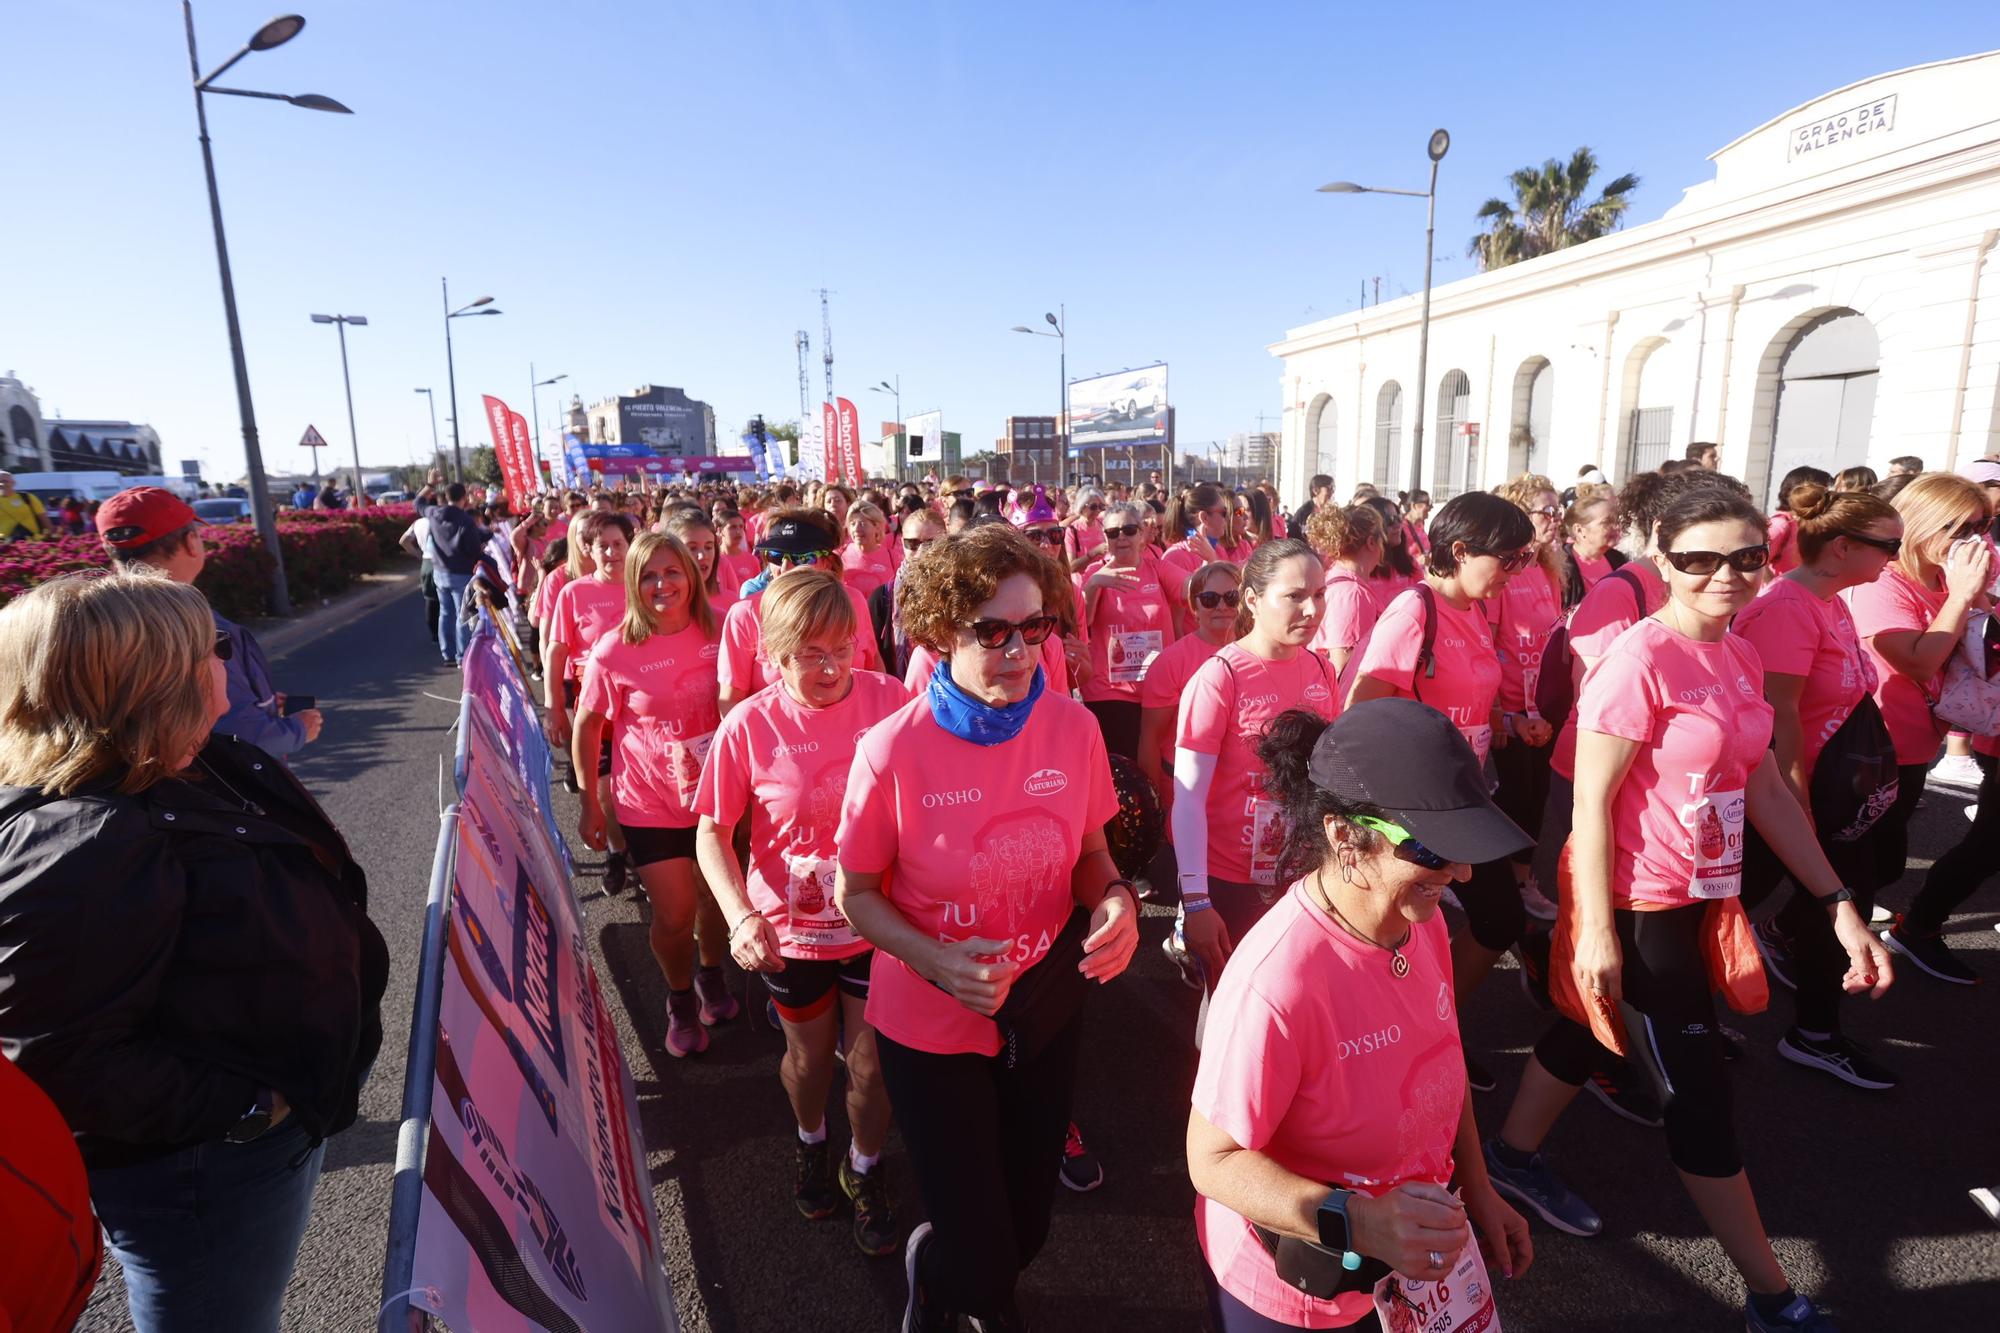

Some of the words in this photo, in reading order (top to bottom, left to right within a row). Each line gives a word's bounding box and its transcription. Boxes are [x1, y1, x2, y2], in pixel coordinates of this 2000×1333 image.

[1799, 117, 1848, 141] GRAO
[1858, 102, 1886, 122] DE
[1794, 117, 1887, 155] VALENCIA
[631, 403, 655, 412] PUERTO
[639, 658, 675, 673] OYSHO
[1239, 693, 1278, 709] OYSHO
[1680, 683, 1724, 702] OYSHO
[1448, 706, 1471, 724] TU
[658, 719, 682, 735] TU
[772, 741, 819, 758] OYSHO
[922, 788, 982, 809] OYSHO
[1702, 881, 1734, 892] OYSHO
[936, 901, 977, 927] TU
[1337, 1024, 1401, 1060] OYSHO
